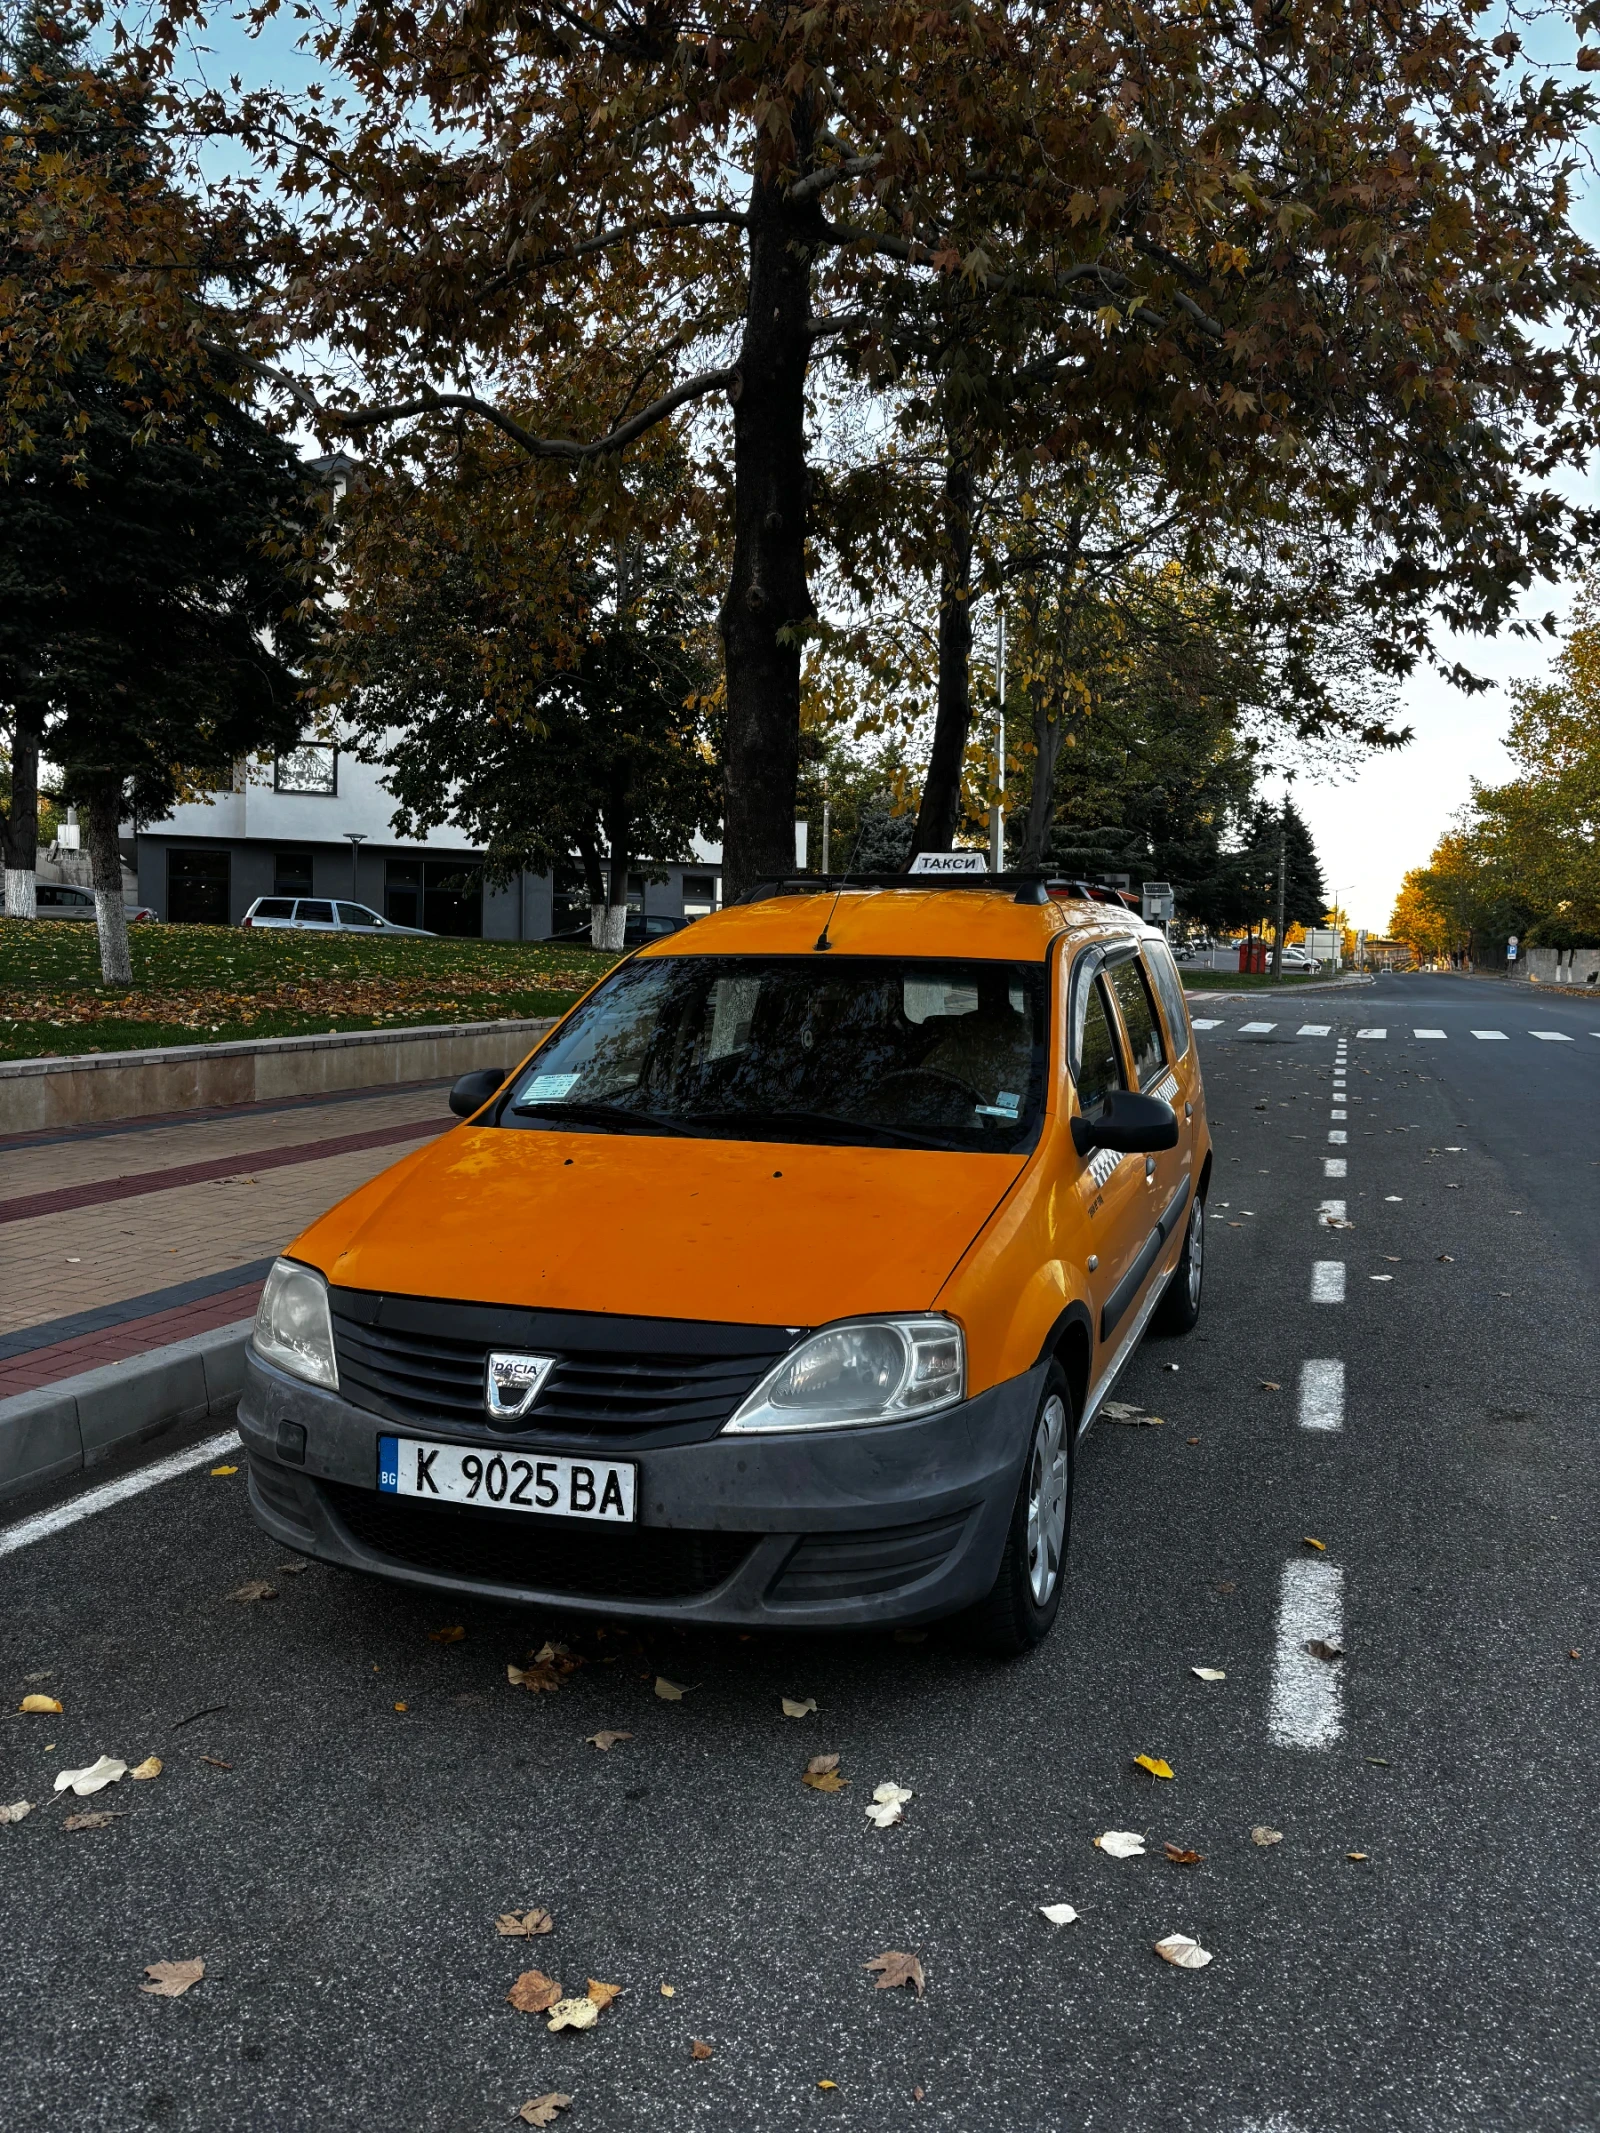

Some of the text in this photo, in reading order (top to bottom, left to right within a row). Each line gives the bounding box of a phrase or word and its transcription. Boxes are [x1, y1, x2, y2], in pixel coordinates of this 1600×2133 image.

[922, 858, 976, 869] ТАКСИ
[494, 1362, 537, 1375] DACIA
[381, 1471, 396, 1485] BG
[416, 1447, 625, 1516] K 9025 BA
